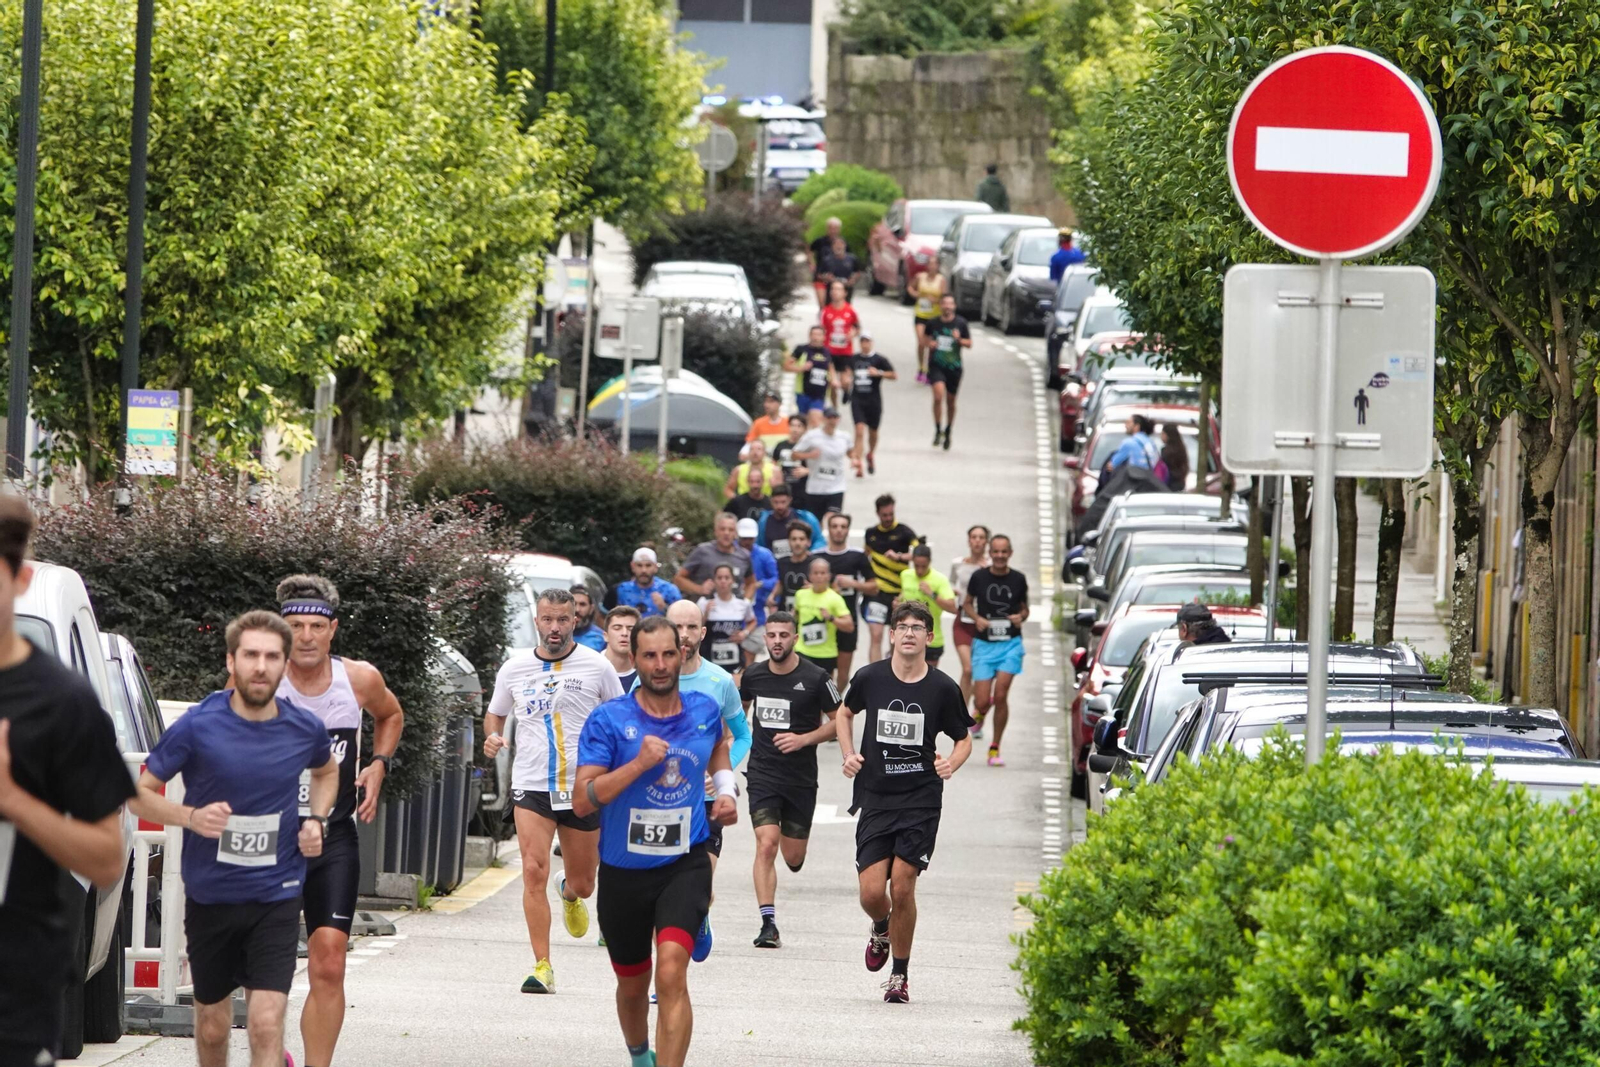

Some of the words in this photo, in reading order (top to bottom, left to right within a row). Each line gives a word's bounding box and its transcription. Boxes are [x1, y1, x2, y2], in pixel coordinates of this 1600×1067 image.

[762, 708, 785, 720] 642
[884, 721, 909, 737] 570
[644, 824, 667, 843] 59
[230, 832, 269, 853] 520
